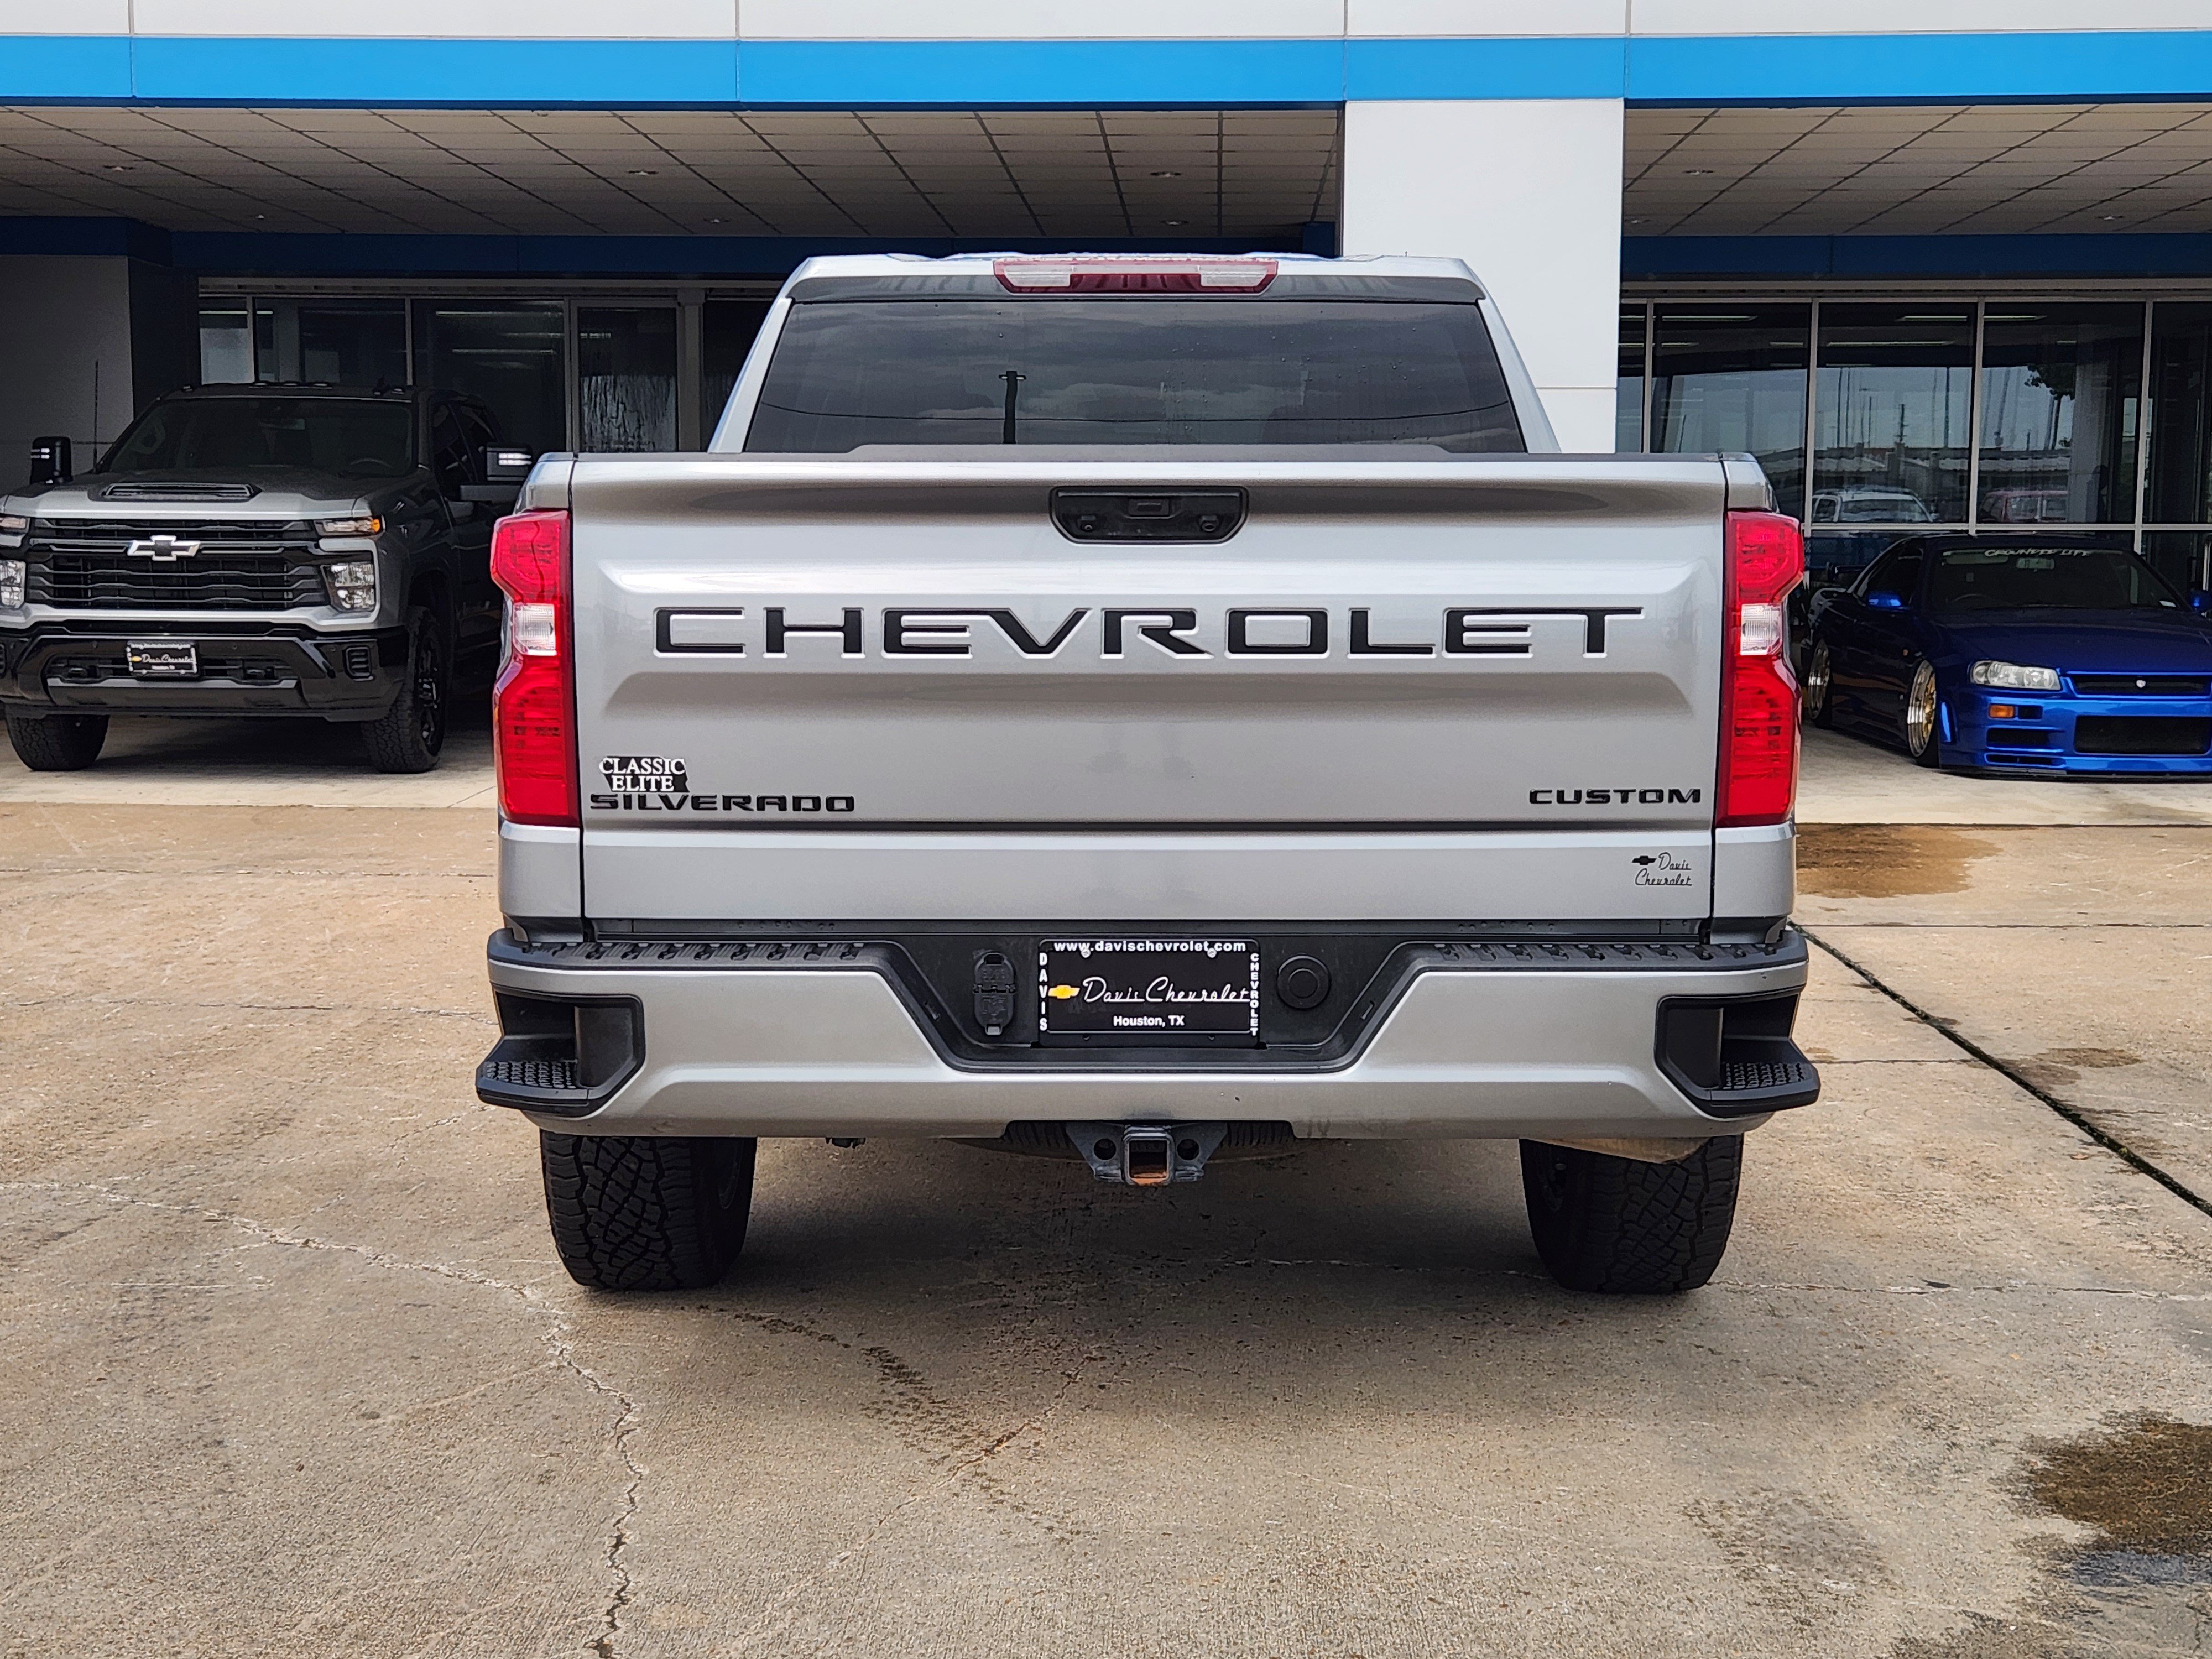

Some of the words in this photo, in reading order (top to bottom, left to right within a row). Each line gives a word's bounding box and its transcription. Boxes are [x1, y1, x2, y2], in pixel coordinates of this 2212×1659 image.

[653, 607, 1644, 658] CHEVROLET
[598, 757, 685, 775] CLASSIC
[611, 775, 675, 792] ELITE
[590, 794, 855, 812] SILVERADO
[1529, 789, 1701, 804] CUSTOM
[1658, 852, 1692, 870] Davis
[1635, 868, 1693, 886] Chevrolet
[1053, 940, 1246, 952] www.davischevroletcom
[1039, 952, 1048, 1031] DAVIS
[1082, 976, 1145, 1003] Davis
[1145, 976, 1250, 1003] Chevrolet
[1249, 952, 1260, 1036] CHEVROLET
[1113, 1015, 1166, 1027] Houston,
[1167, 1015, 1185, 1026] TX
